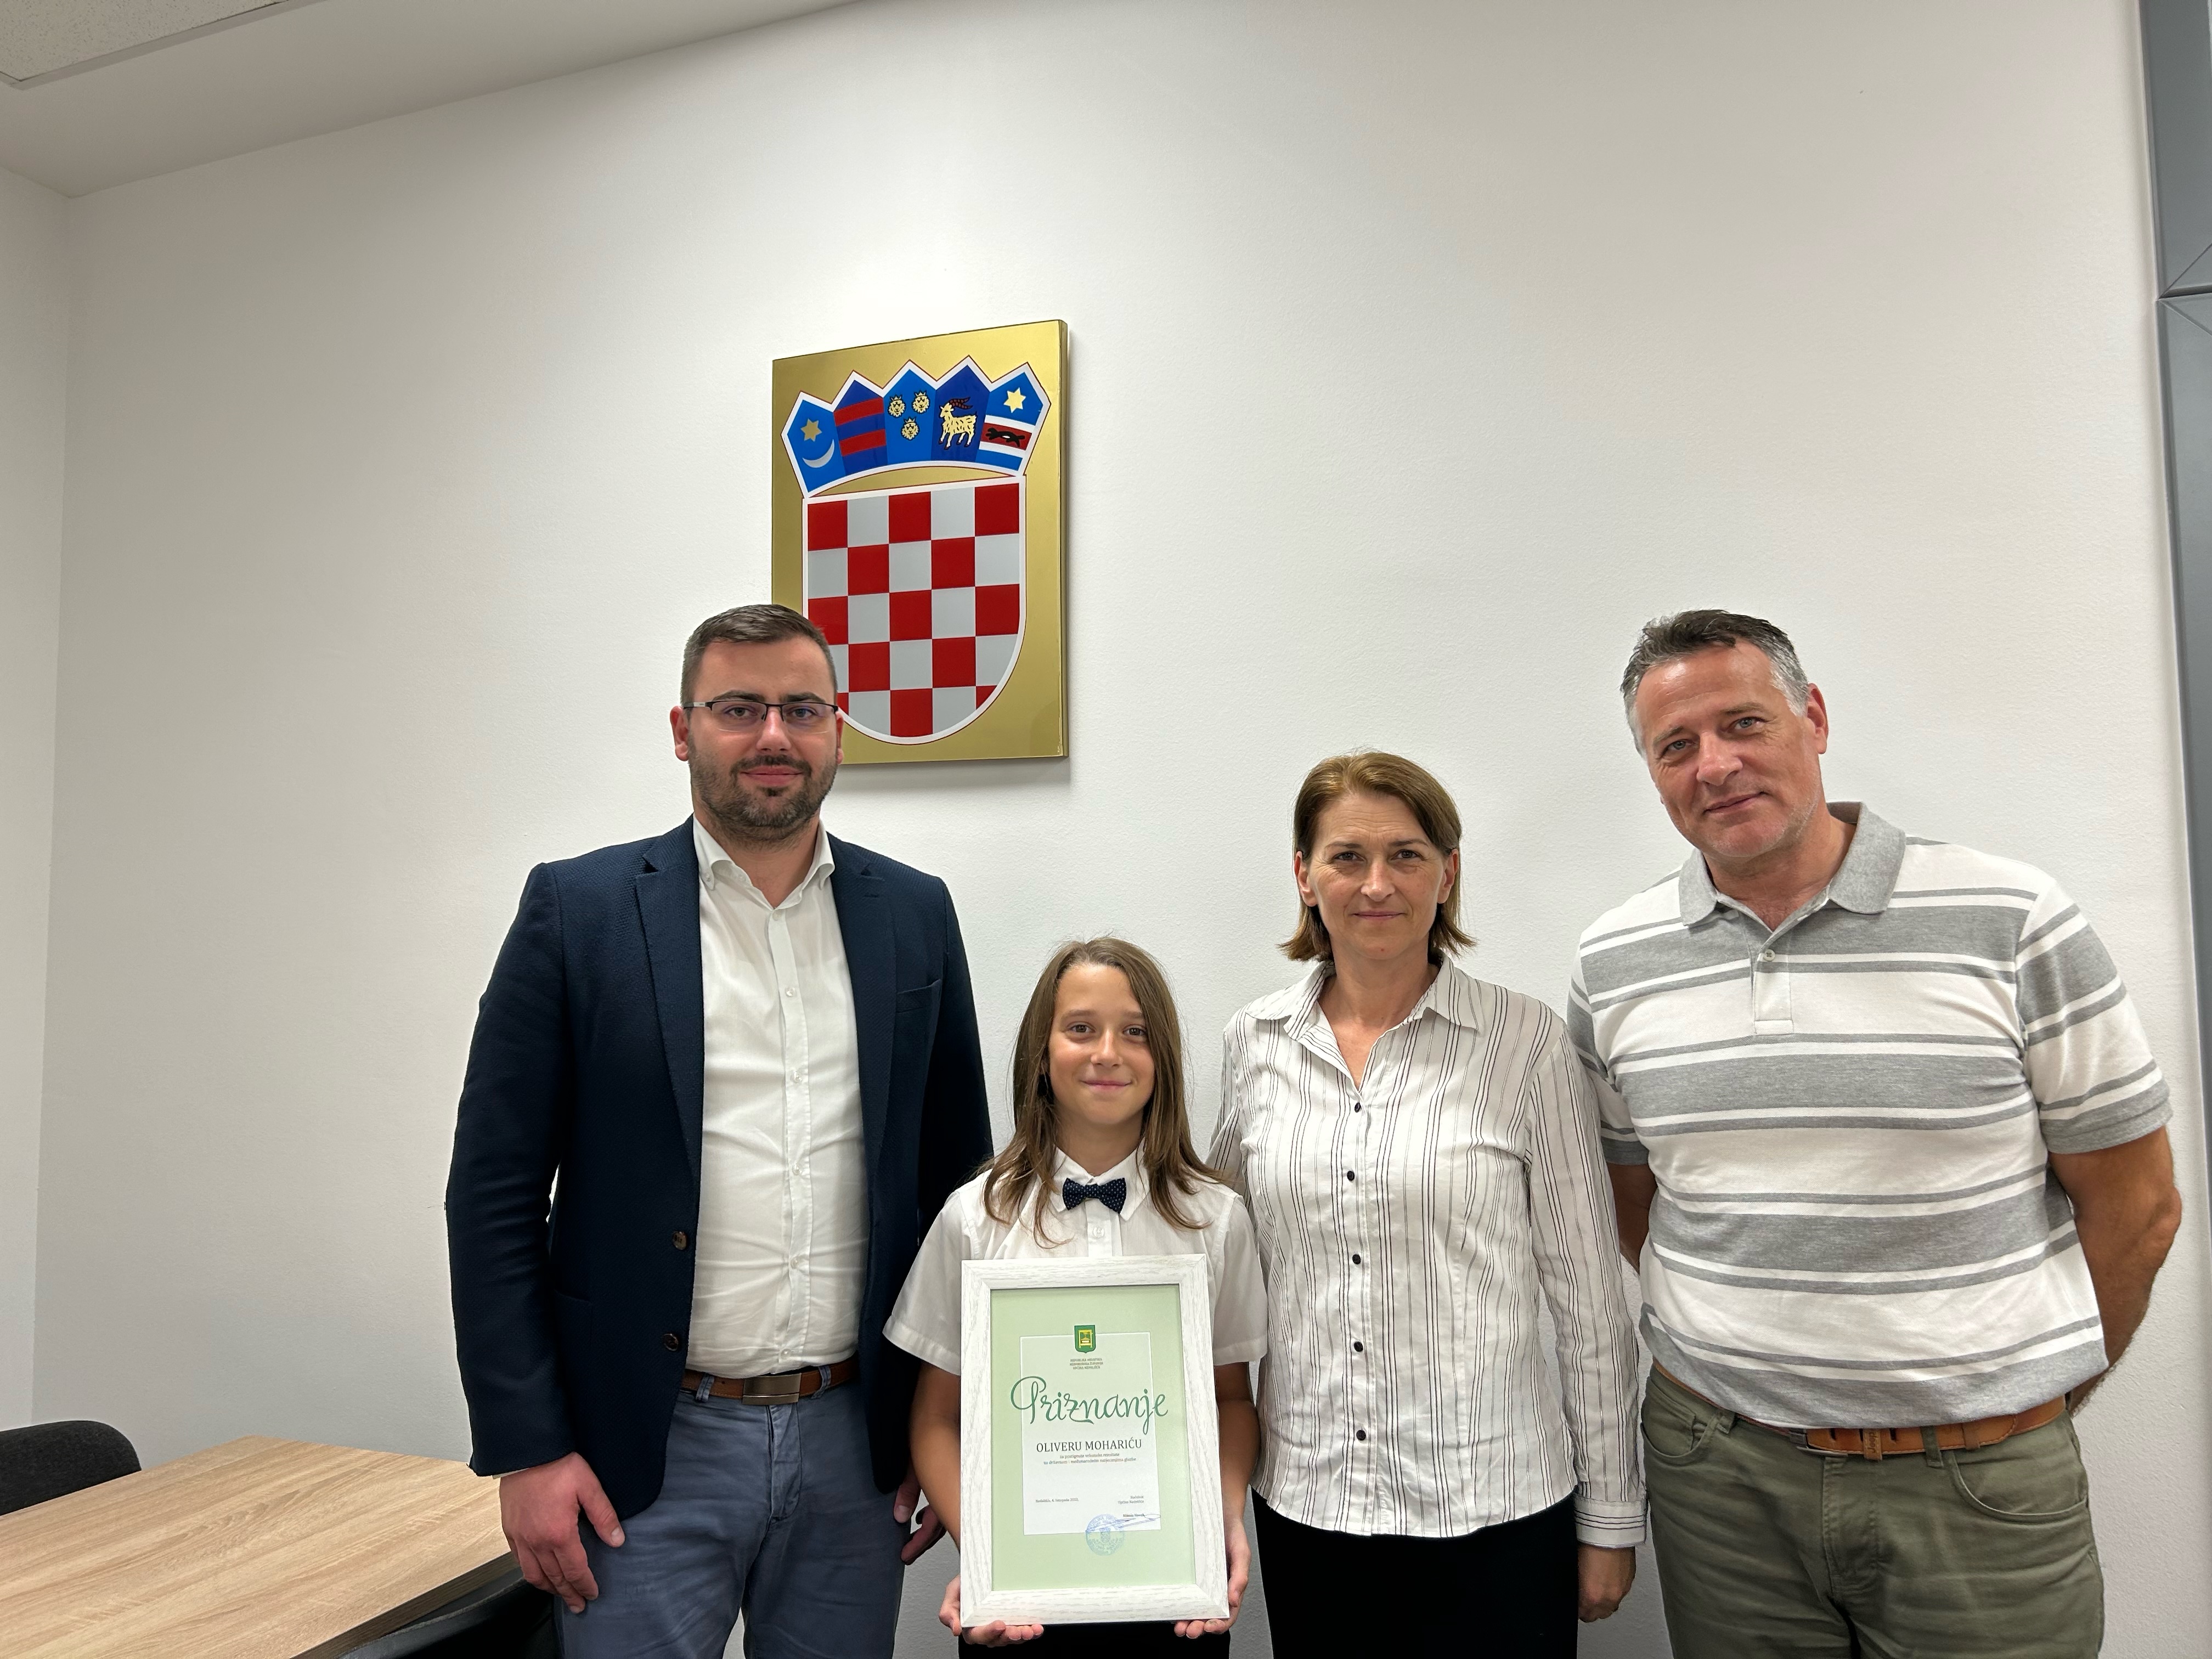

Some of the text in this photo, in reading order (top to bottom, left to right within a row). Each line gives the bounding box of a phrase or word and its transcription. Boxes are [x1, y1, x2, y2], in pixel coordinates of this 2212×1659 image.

[1011, 1376, 1169, 1435] Priznanje
[1036, 1436, 1142, 1452] OLIVERU MOHARIĆU
[1867, 1432, 1878, 1453] Jeep
